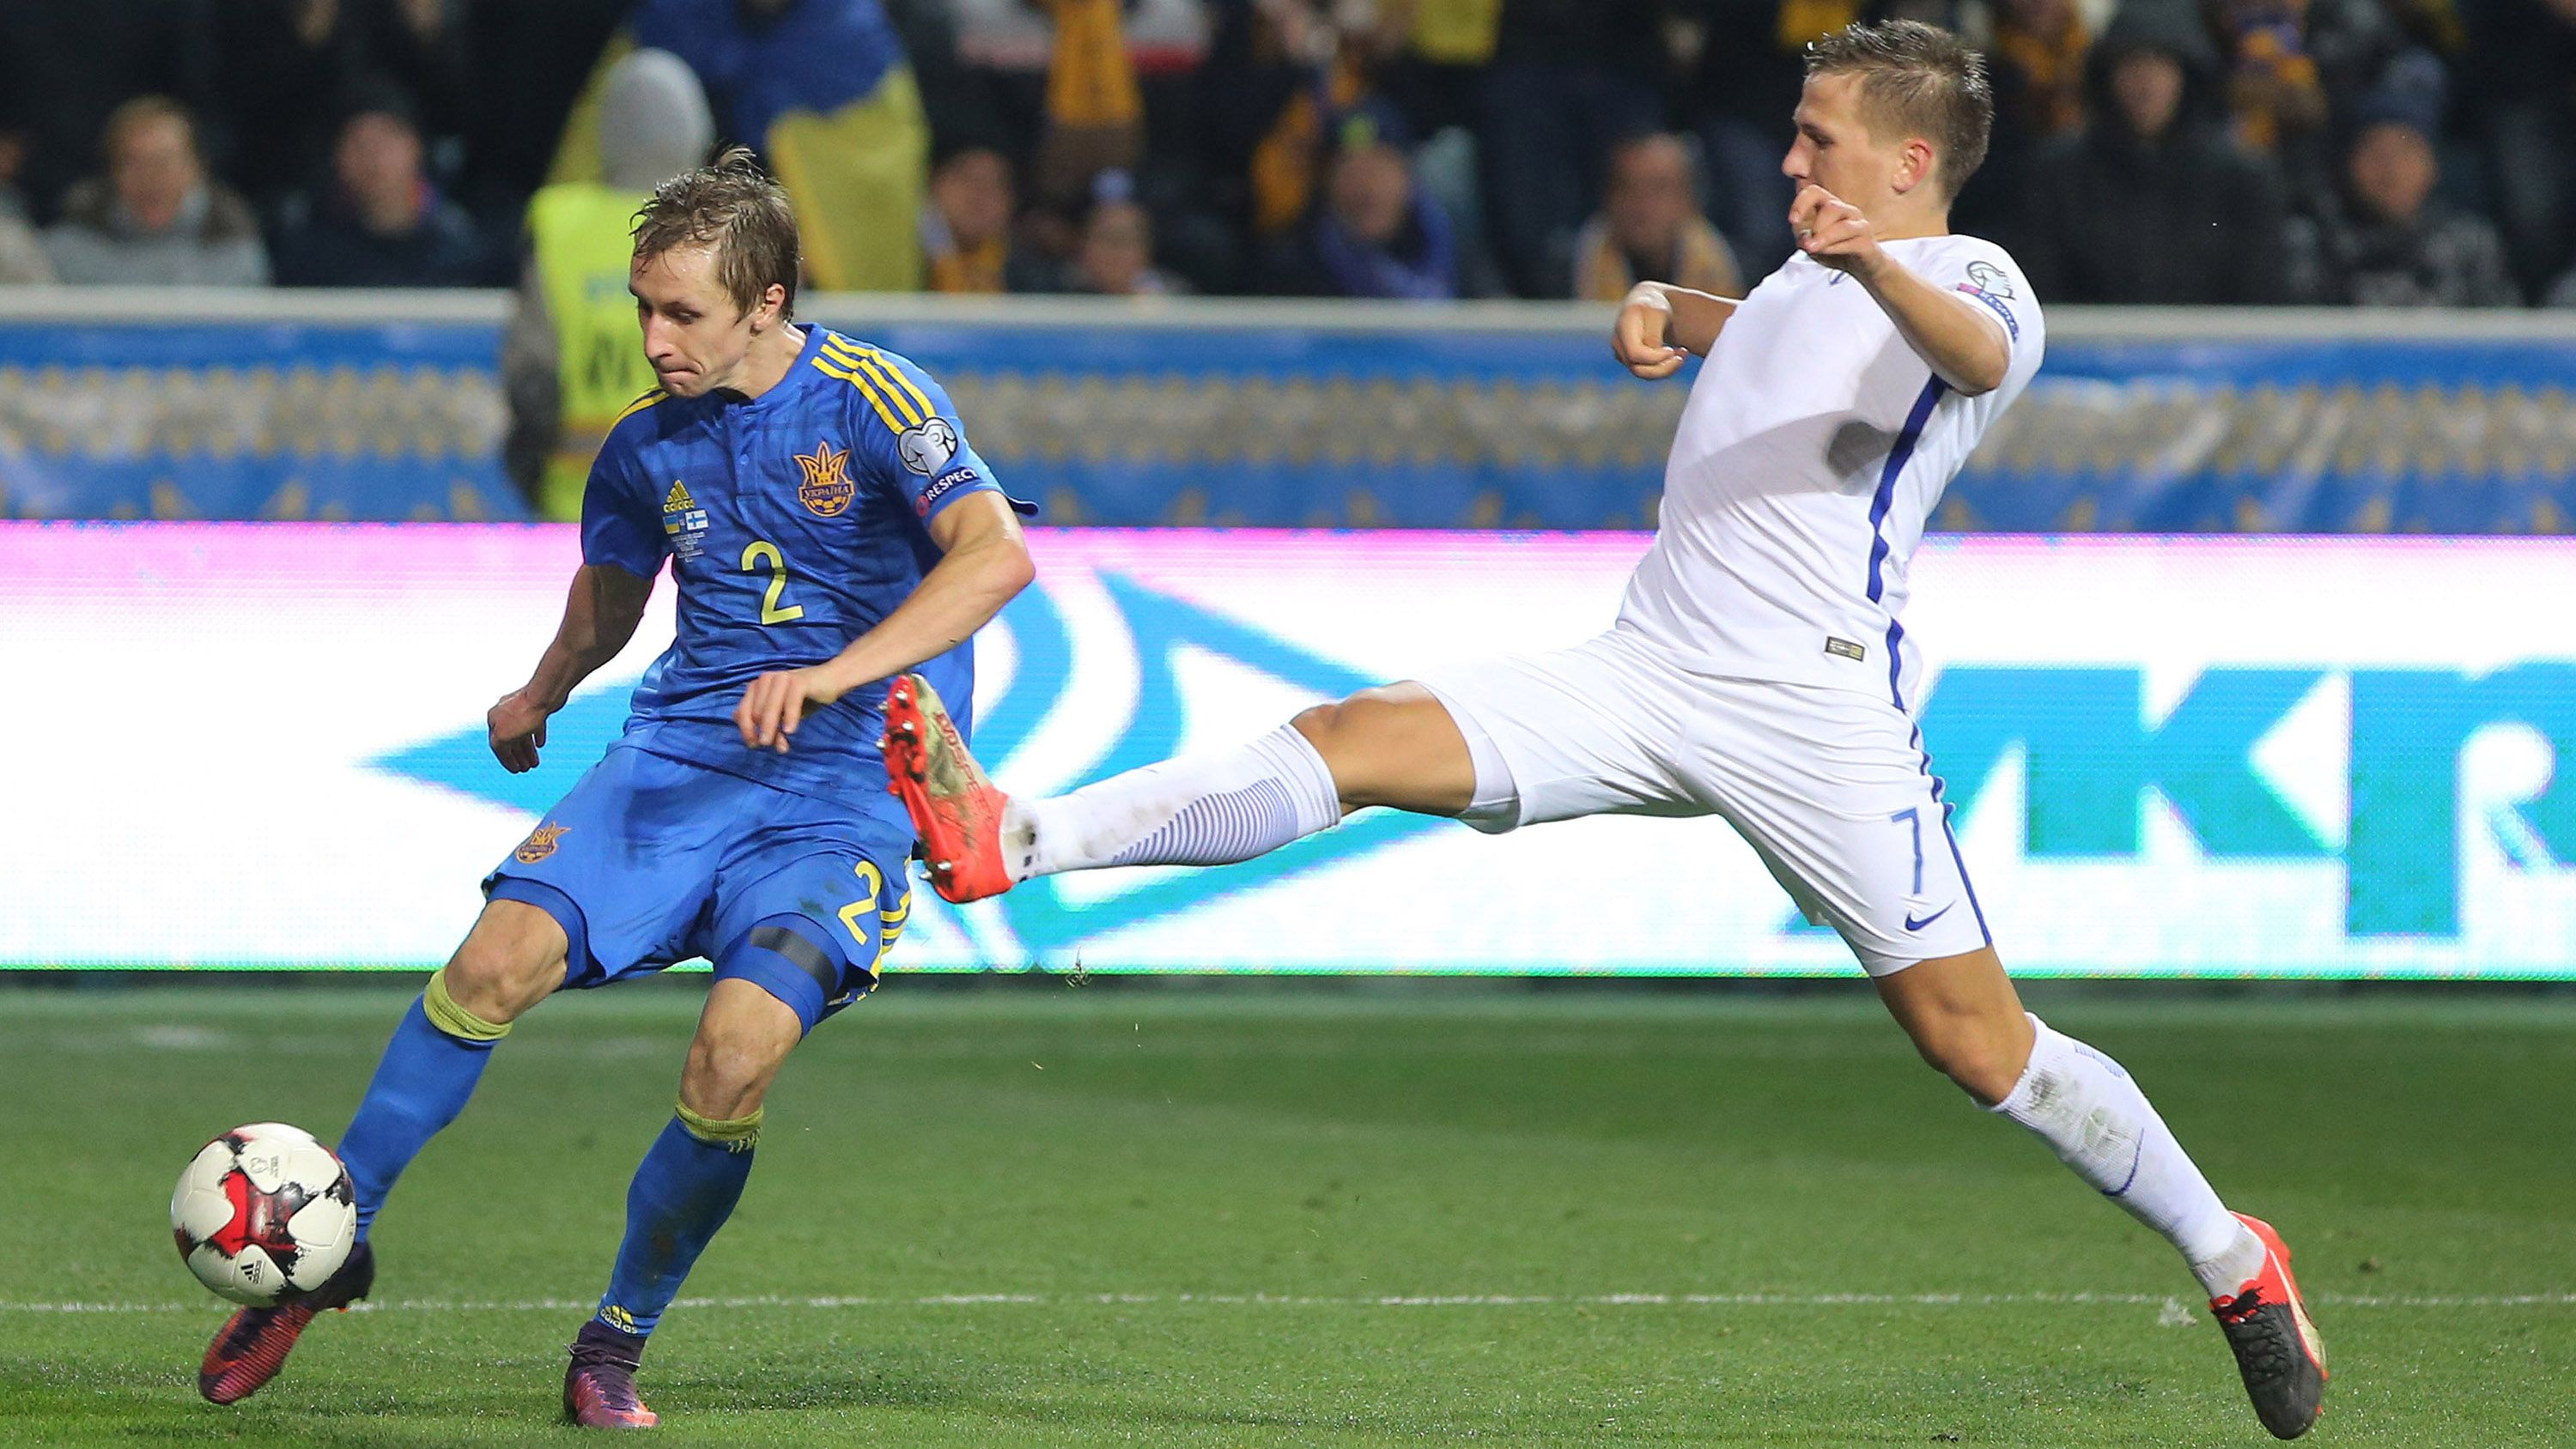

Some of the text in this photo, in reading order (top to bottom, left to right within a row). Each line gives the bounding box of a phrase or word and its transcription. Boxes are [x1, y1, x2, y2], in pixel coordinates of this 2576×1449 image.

[663, 499, 696, 513] adidas
[926, 468, 977, 501] RESPECT
[741, 541, 804, 626] 2
[1891, 807, 1923, 894] 7
[837, 860, 883, 946] 2
[600, 1308, 637, 1334] adidas
